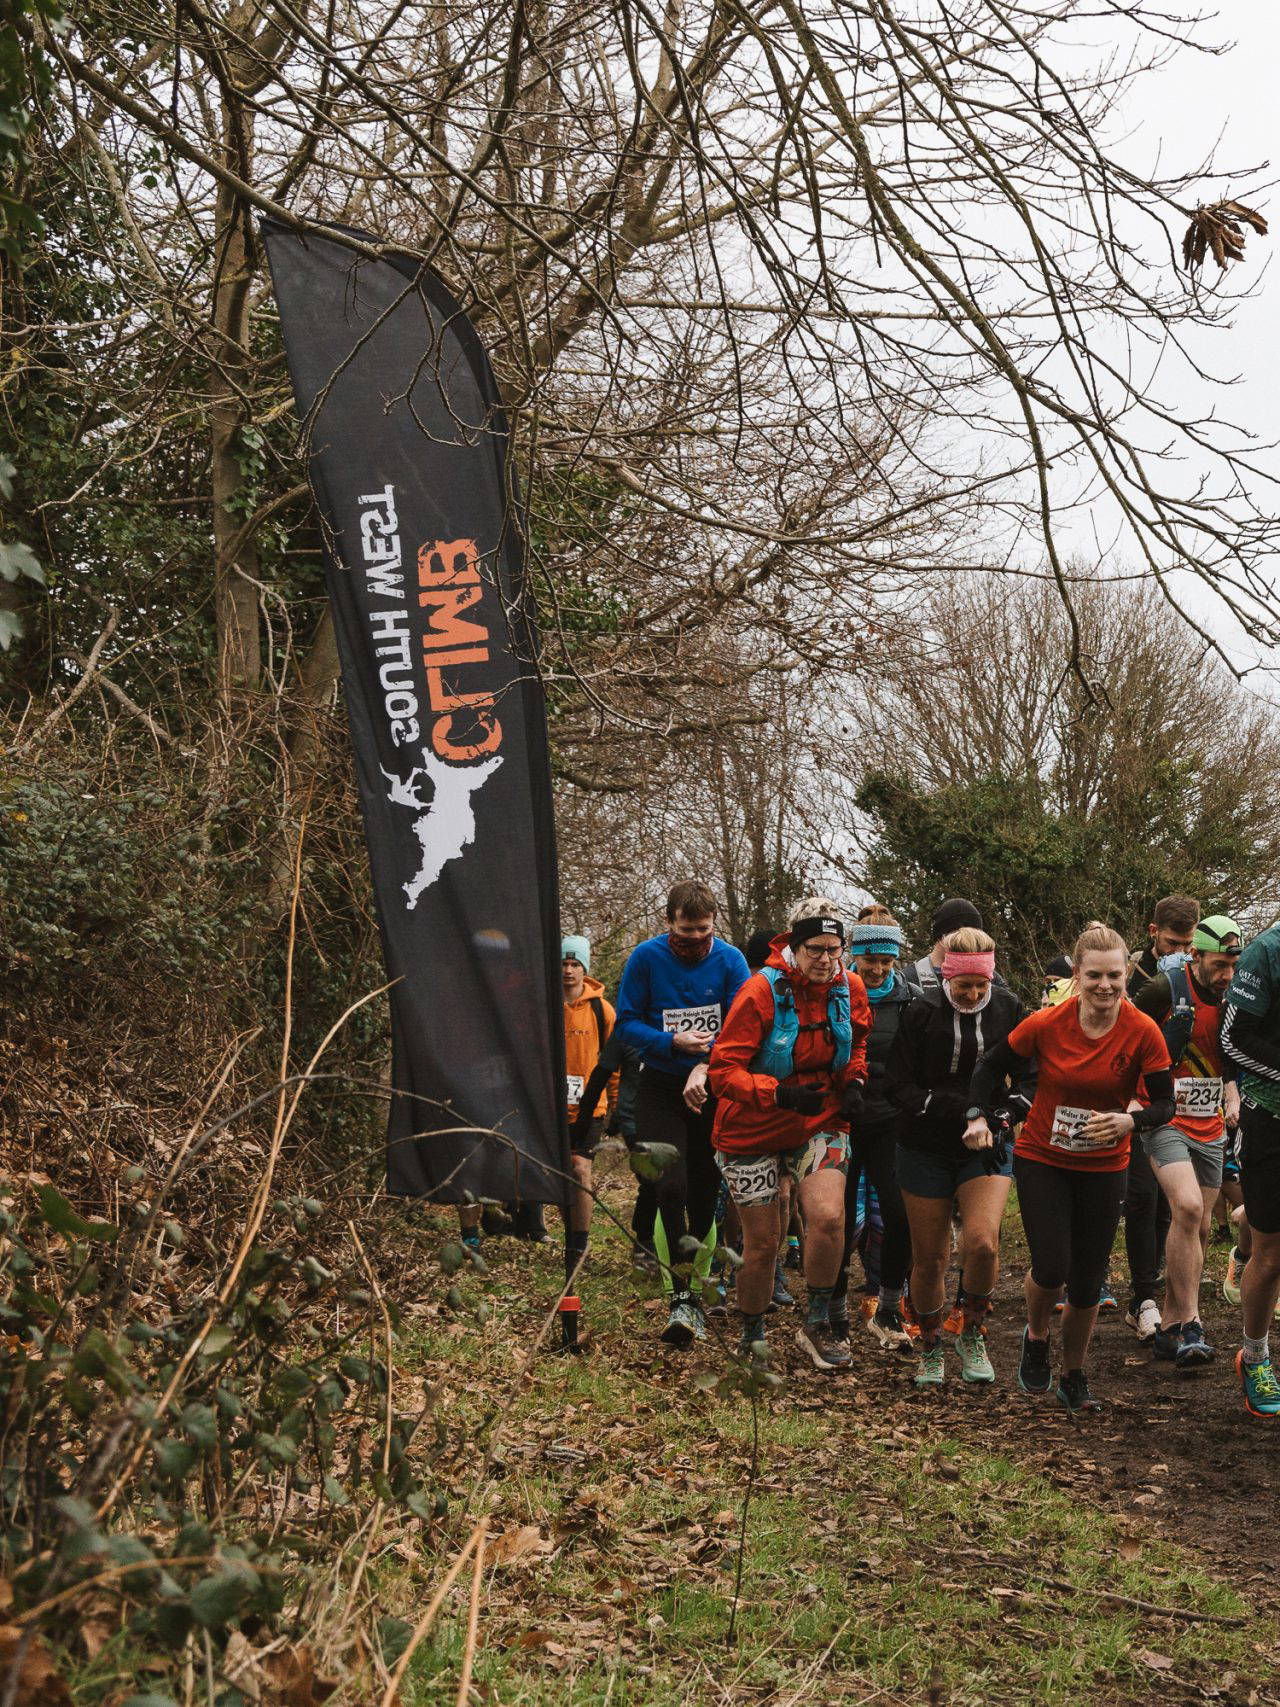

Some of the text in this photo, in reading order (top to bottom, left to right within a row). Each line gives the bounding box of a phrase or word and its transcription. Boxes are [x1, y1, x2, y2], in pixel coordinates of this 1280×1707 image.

[1239, 969, 1261, 984] QATAR
[1232, 985, 1256, 1000] wahoo
[680, 1014, 719, 1032] 226
[1188, 1088, 1221, 1105] 234
[1060, 1109, 1078, 1119] Walter
[739, 1169, 776, 1193] 220
